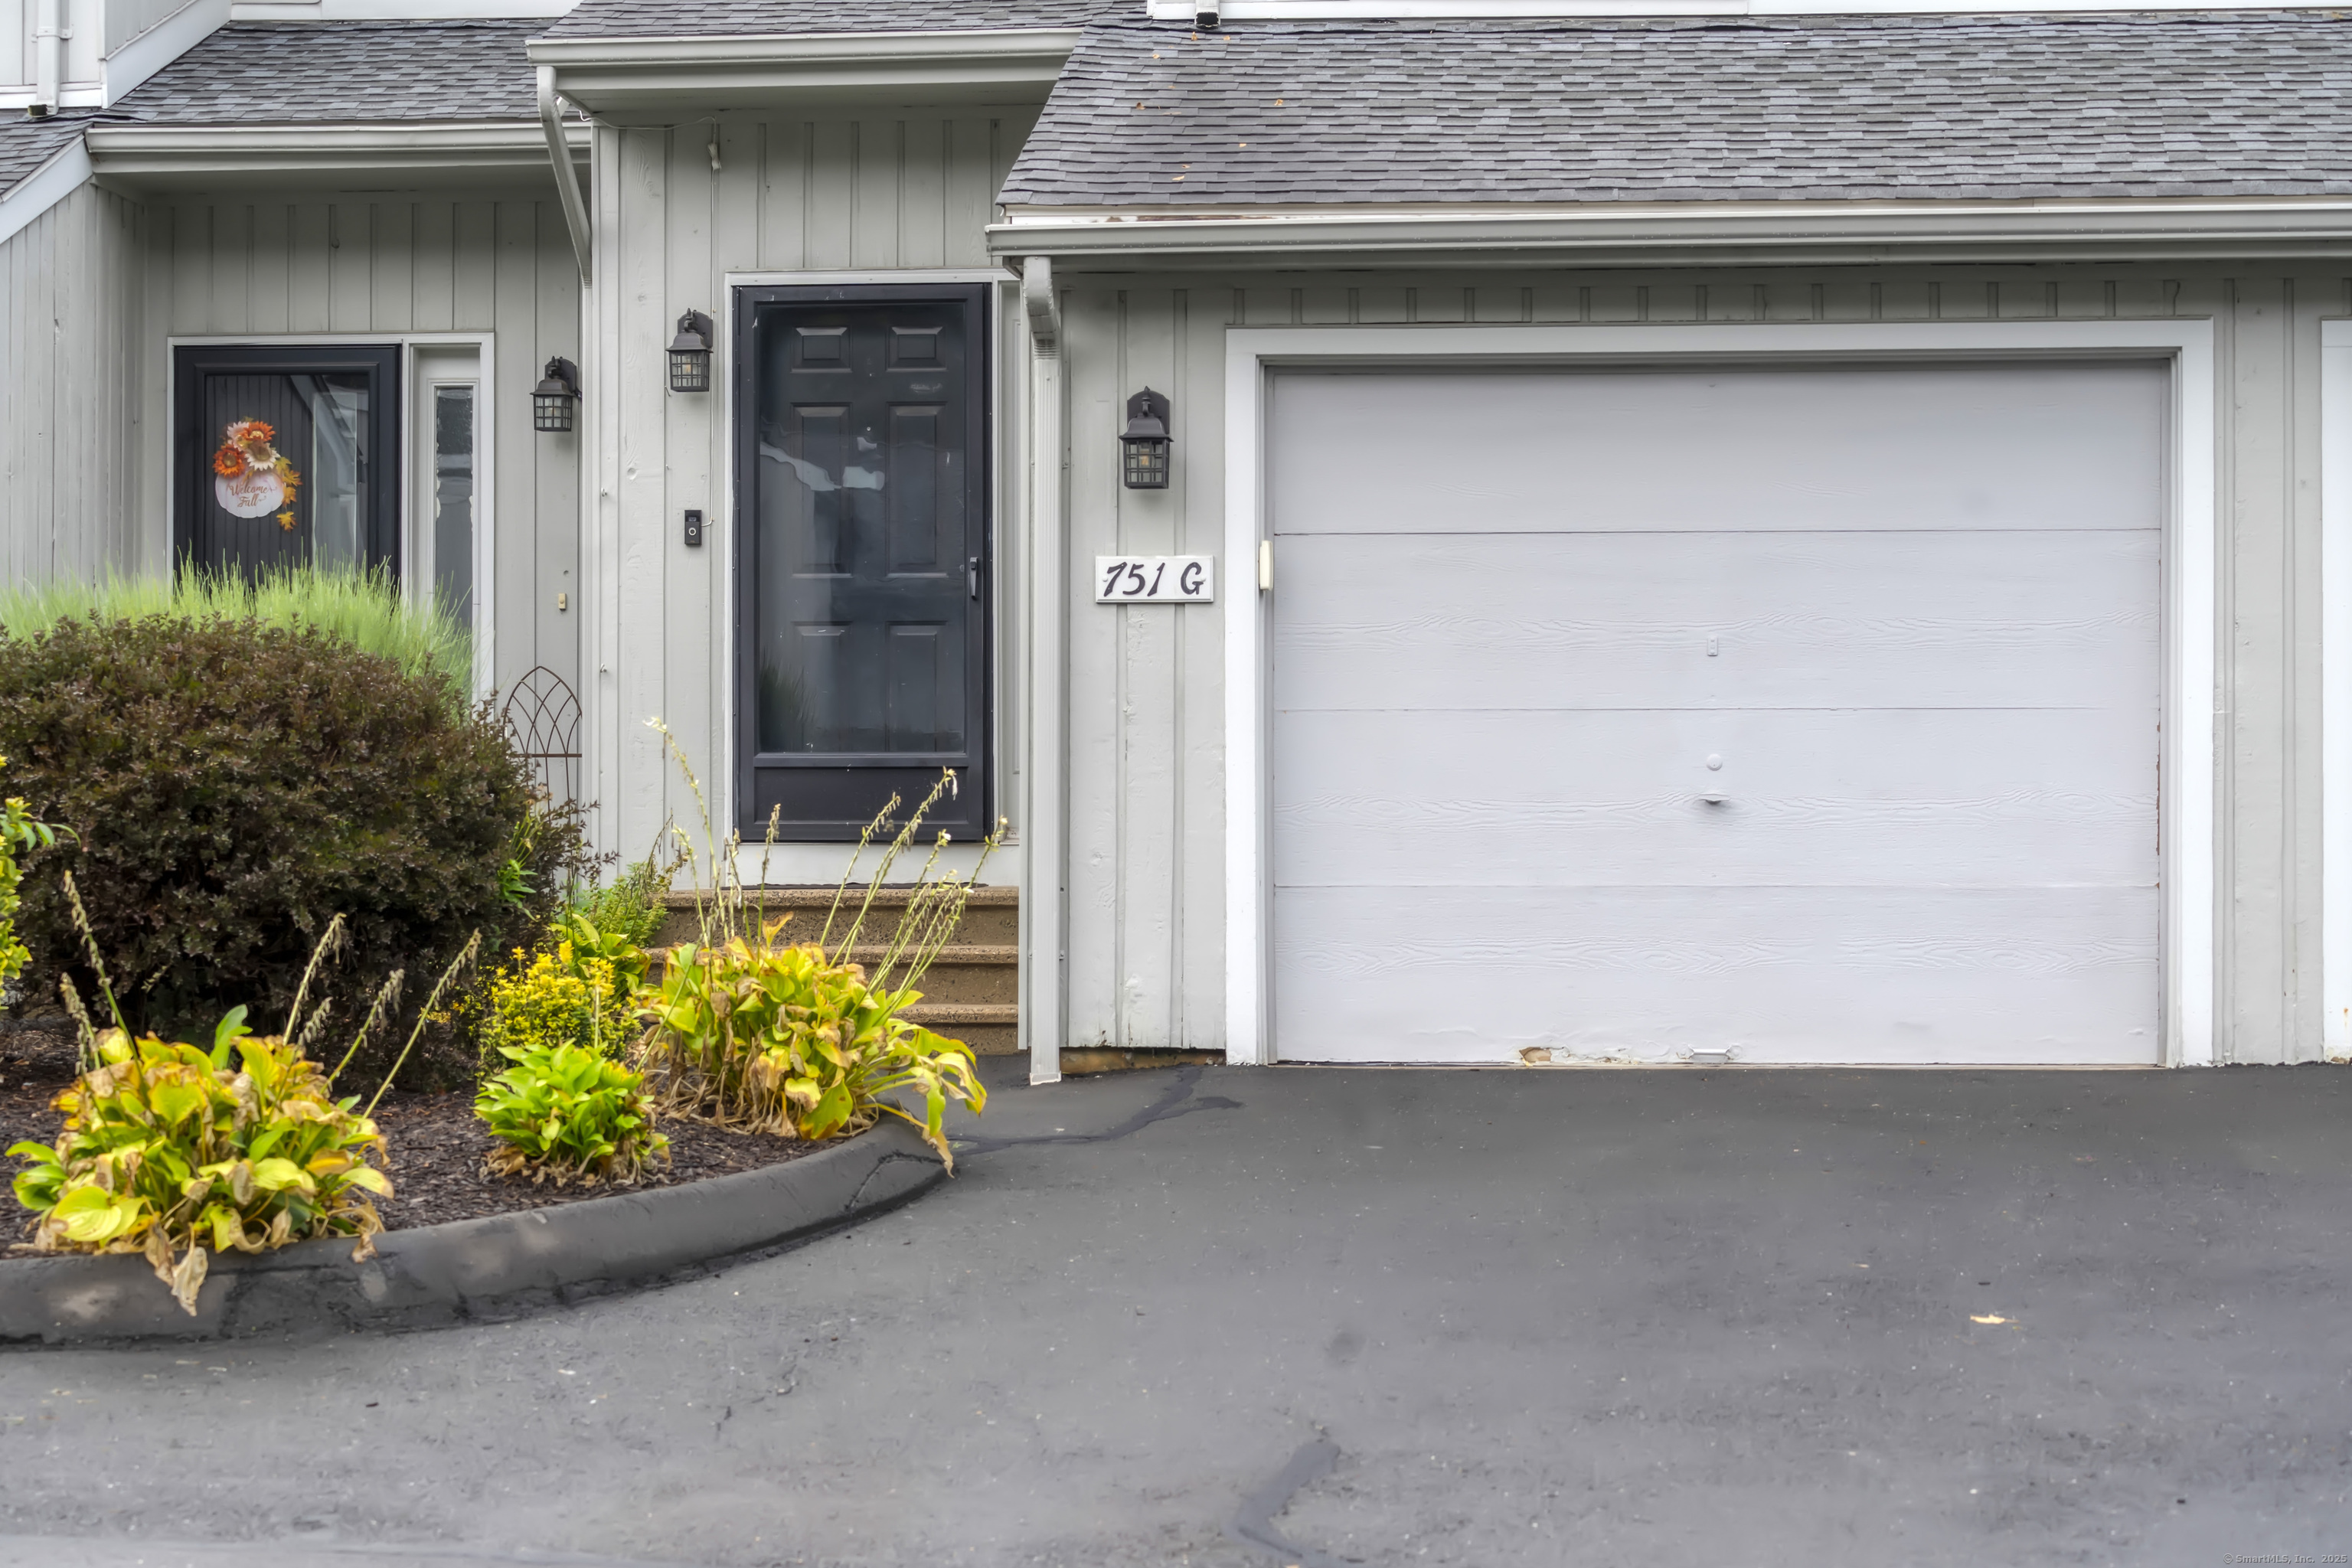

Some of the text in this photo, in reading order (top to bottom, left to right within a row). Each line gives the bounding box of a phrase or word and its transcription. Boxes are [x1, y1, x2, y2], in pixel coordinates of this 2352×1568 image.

[227, 482, 268, 495] Welcome
[237, 494, 265, 507] Fall
[1103, 561, 1204, 597] 751 G
